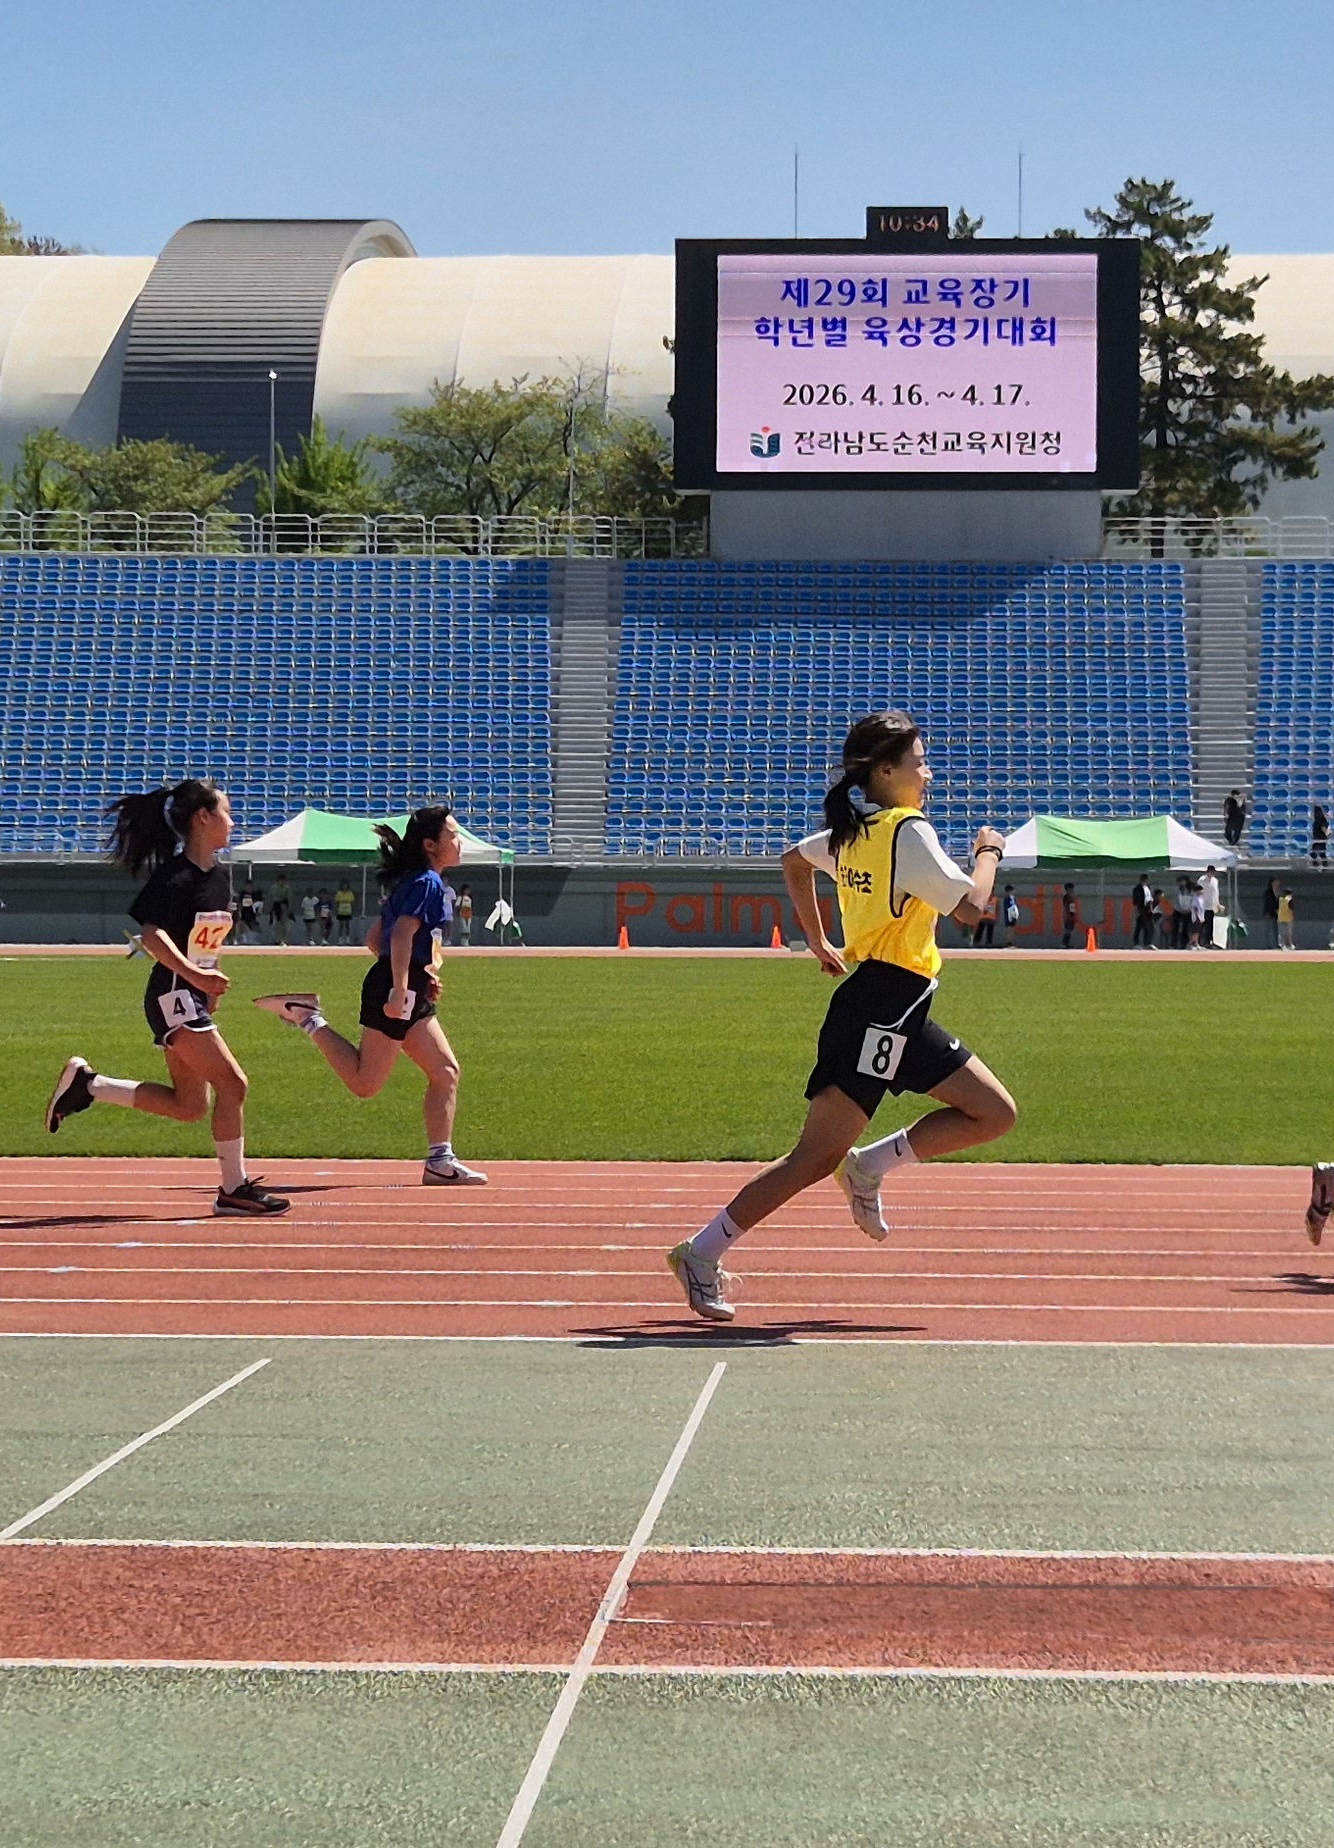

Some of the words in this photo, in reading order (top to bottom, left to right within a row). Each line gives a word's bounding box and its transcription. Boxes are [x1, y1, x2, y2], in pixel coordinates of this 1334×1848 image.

[879, 214, 940, 233] 10:34
[779, 277, 889, 310] 제29회
[901, 277, 1031, 310] 교육장기
[753, 315, 849, 348] 학년별
[861, 315, 1057, 348] 육상경기대회
[793, 430, 1063, 457] 전라남도순천교육지원청
[194, 926, 225, 949] 42
[172, 996, 187, 1016] 4
[871, 1034, 894, 1075] 8
